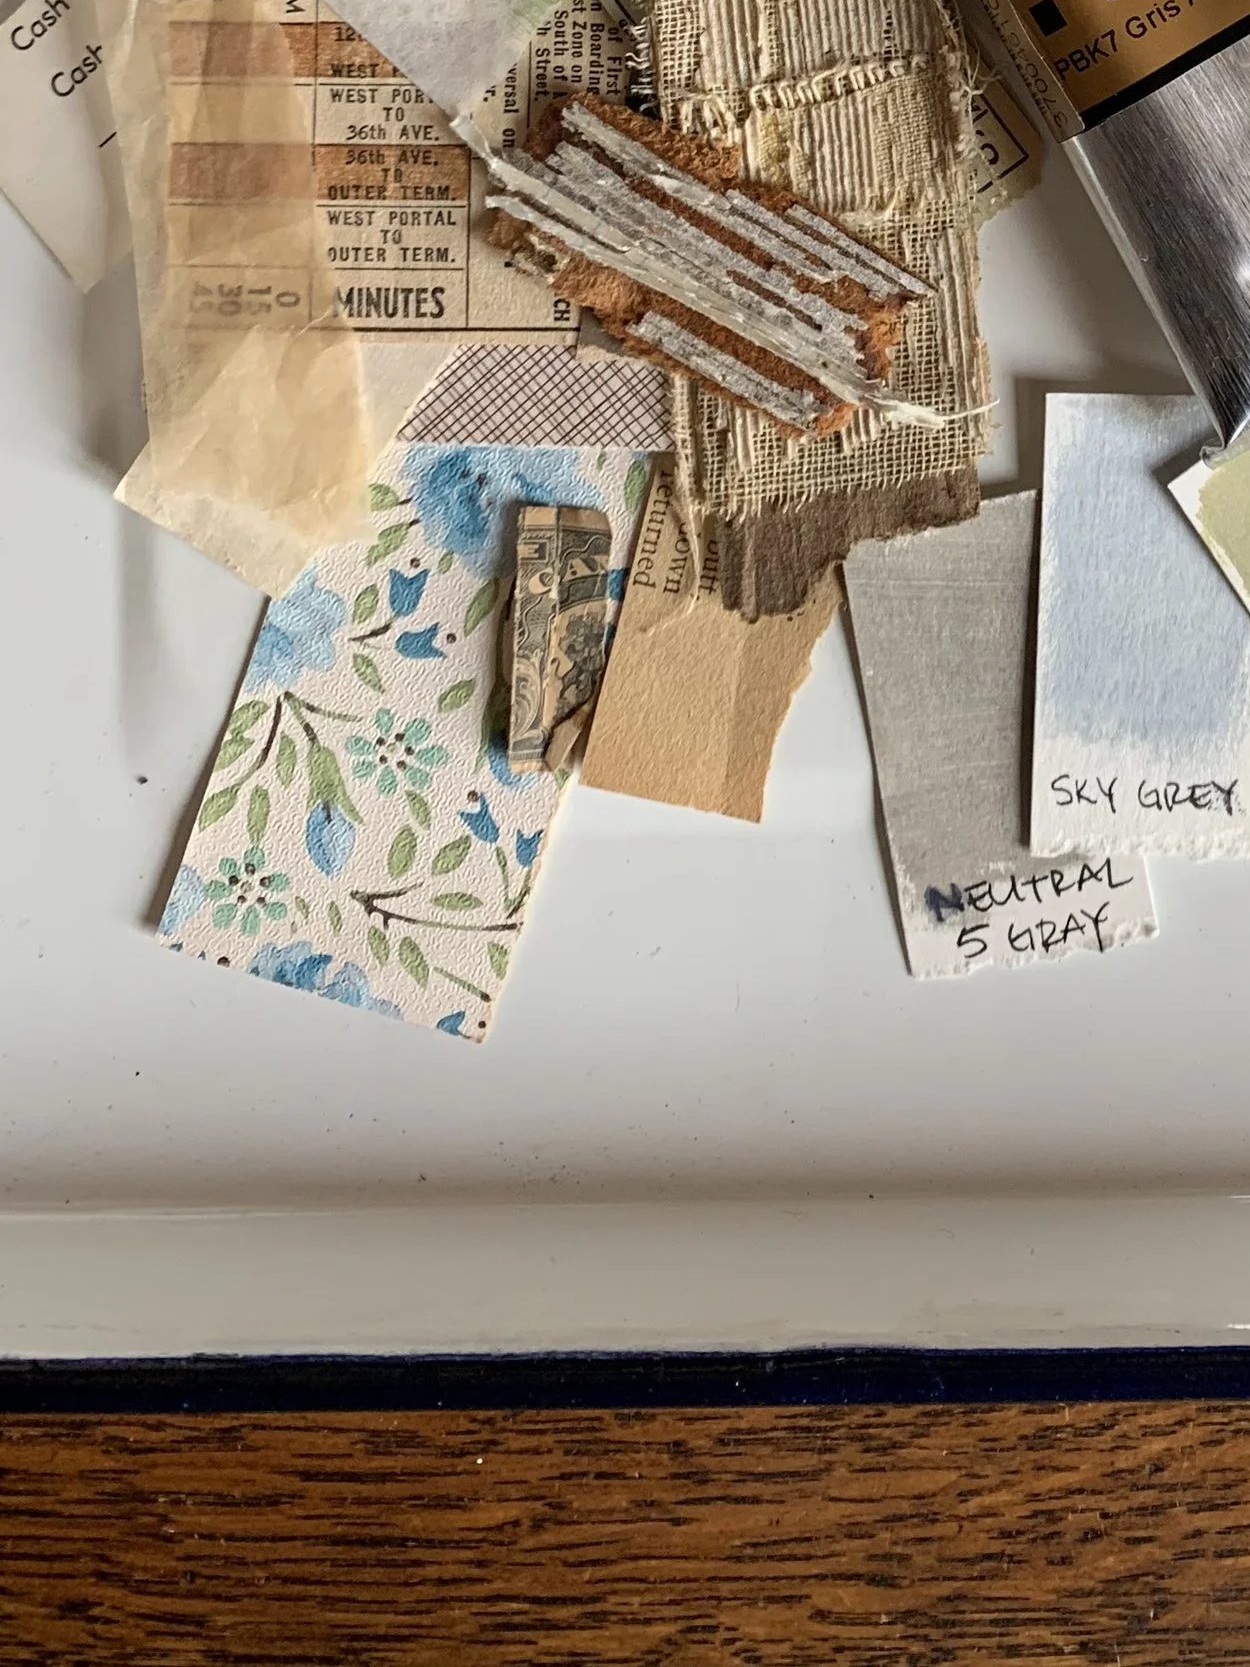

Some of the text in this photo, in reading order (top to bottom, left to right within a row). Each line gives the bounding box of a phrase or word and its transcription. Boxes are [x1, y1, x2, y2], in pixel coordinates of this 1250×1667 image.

[553, 10, 569, 57] South
[571, 21, 587, 59] Zone
[587, 23, 605, 96] Boarding
[1053, 29, 1119, 81] PBK7
[534, 47, 551, 102] Street.
[553, 65, 568, 83] of
[571, 65, 583, 84] on
[606, 56, 623, 96] First
[329, 88, 379, 104] WEST
[383, 106, 404, 122] TO
[346, 125, 440, 141] 36th AVE.
[503, 128, 516, 148] on
[345, 150, 439, 166] 36th AVE.
[381, 168, 403, 184] TO
[328, 185, 457, 201] OUTER TERM.
[327, 210, 456, 226] WEST PORTAL
[380, 230, 402, 244] TO
[328, 247, 457, 262] OUTER TERM.
[337, 285, 446, 320] MINUTES
[1050, 774, 1240, 817] SKY GREY
[924, 857, 1134, 924] NEUTRAL
[957, 901, 1112, 959] 5 GRAY
